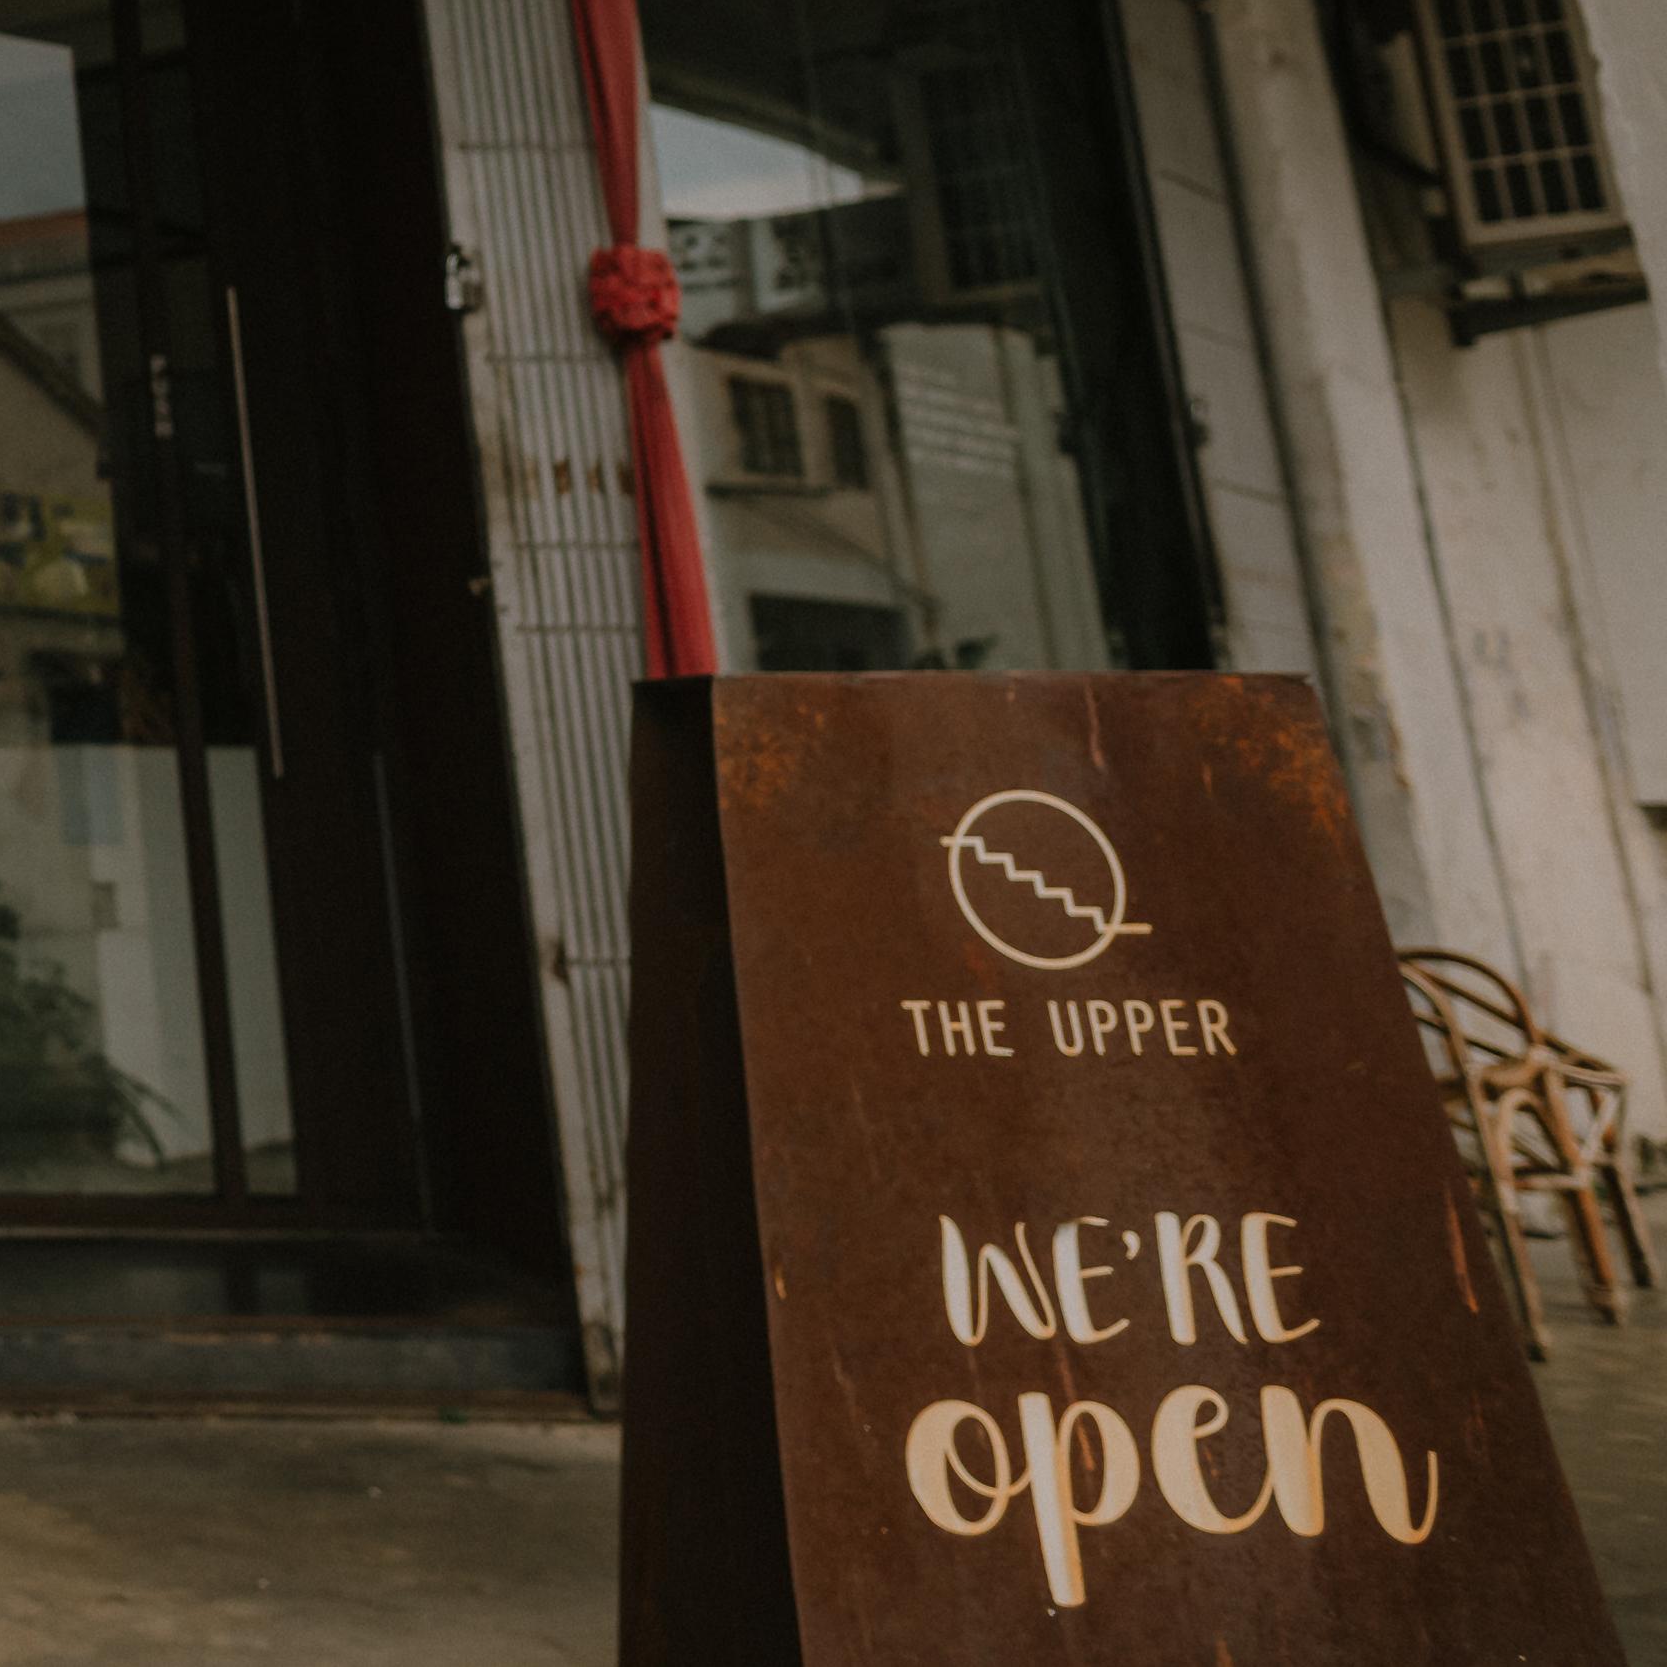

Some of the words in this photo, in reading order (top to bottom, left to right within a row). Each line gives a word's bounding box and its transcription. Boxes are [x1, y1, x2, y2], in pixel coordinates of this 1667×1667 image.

[900, 999, 1015, 1057] THE
[1047, 998, 1239, 1057] UPPER
[904, 1383, 1440, 1608] open
